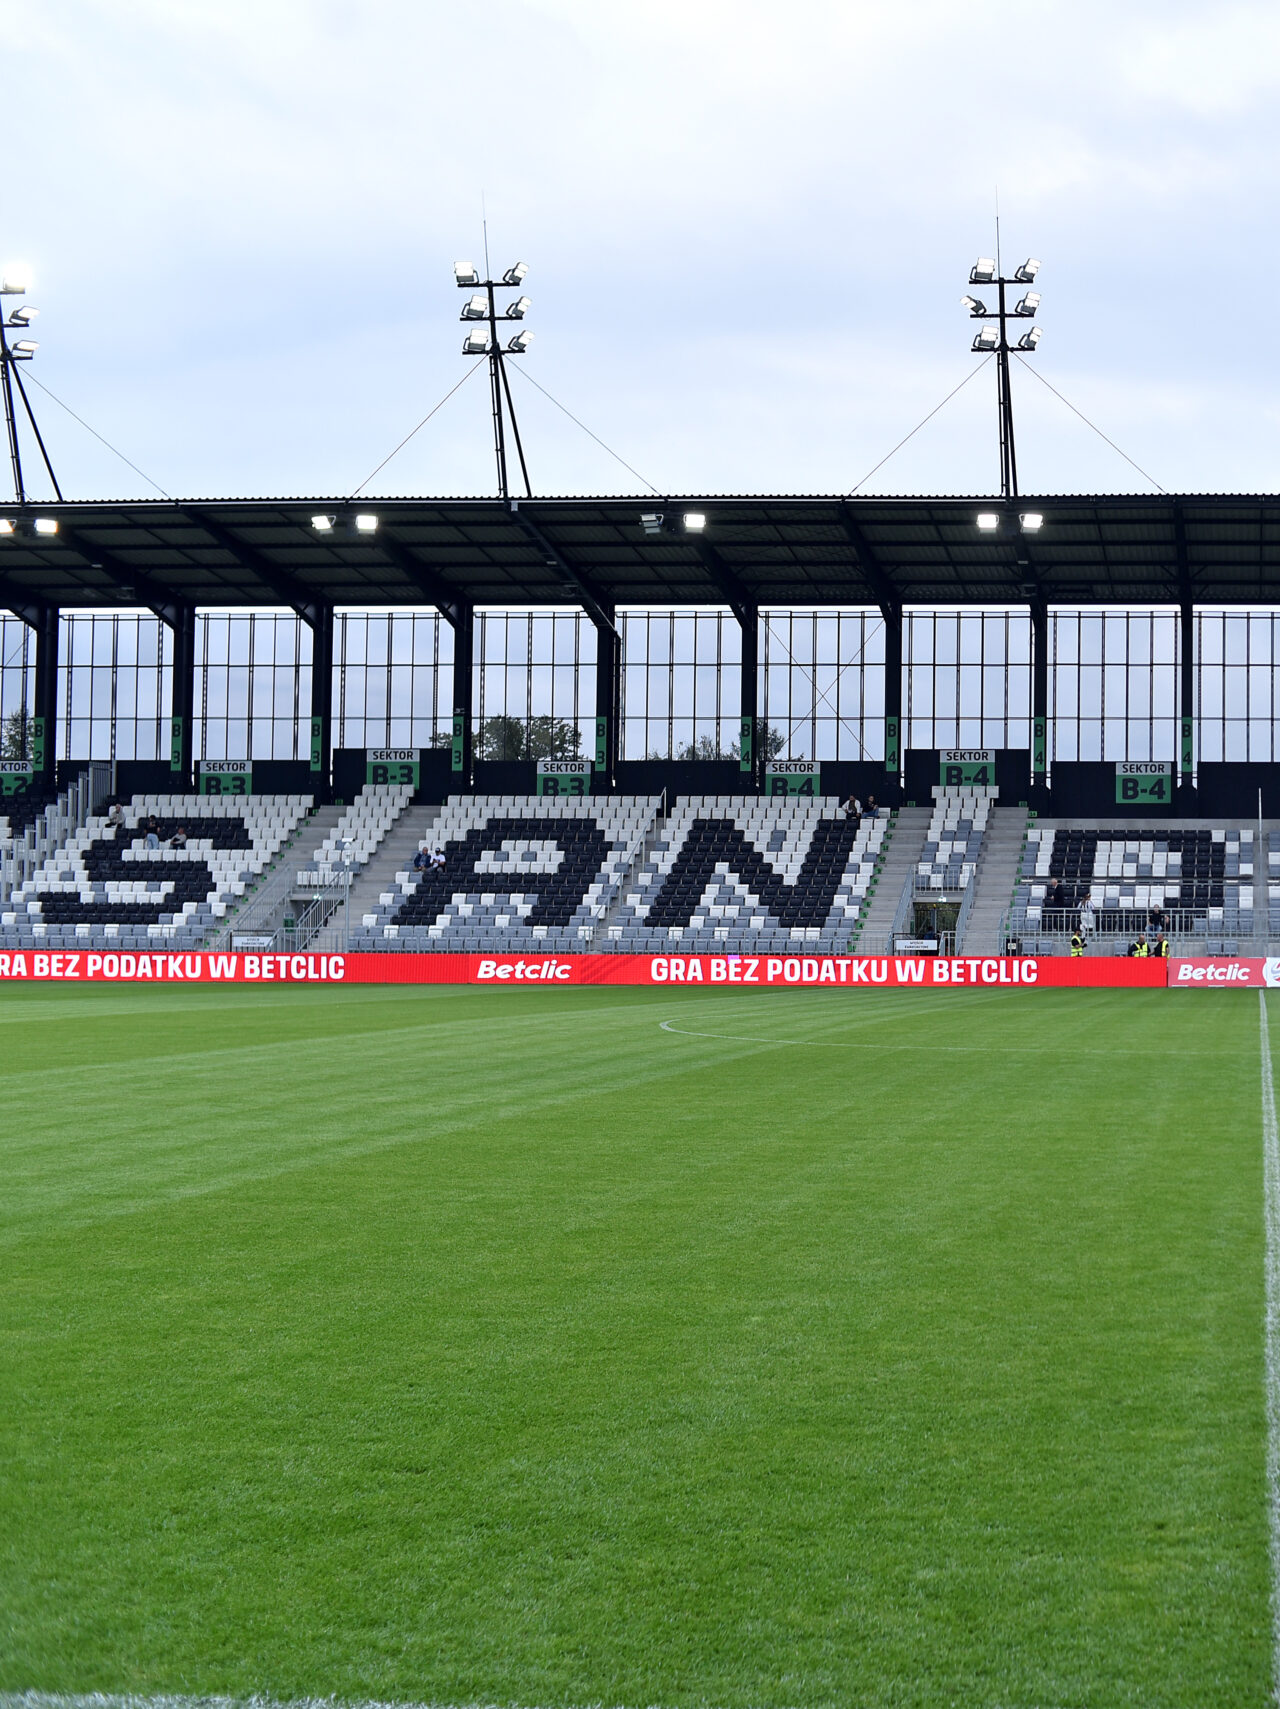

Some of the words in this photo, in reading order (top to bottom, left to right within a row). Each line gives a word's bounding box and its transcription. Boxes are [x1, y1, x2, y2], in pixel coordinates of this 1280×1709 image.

[372, 750, 414, 760] SEKTOR
[946, 751, 989, 761] SEKTOR
[205, 762, 246, 772] SEKTOR
[372, 765, 414, 785] B-3
[543, 762, 585, 773] SEKTOR
[771, 762, 814, 773] SEKTOR
[946, 766, 990, 786] B-4
[1122, 763, 1165, 773] SEKTOR
[205, 776, 246, 795] B-3
[542, 777, 585, 796] B-3
[771, 777, 815, 796] B-4
[1122, 778, 1166, 800] B-4
[33, 954, 80, 977] BEZ
[87, 954, 202, 978] PODATKU
[209, 955, 238, 979] W
[245, 955, 345, 979] BETCLIC
[477, 960, 572, 979] Betclic
[651, 959, 703, 981] GRA
[710, 959, 760, 982] BEZ
[768, 959, 888, 983] PODATKU
[894, 960, 926, 983] W
[932, 960, 1038, 984] BETCLIC
[1178, 963, 1251, 980] Betclic
